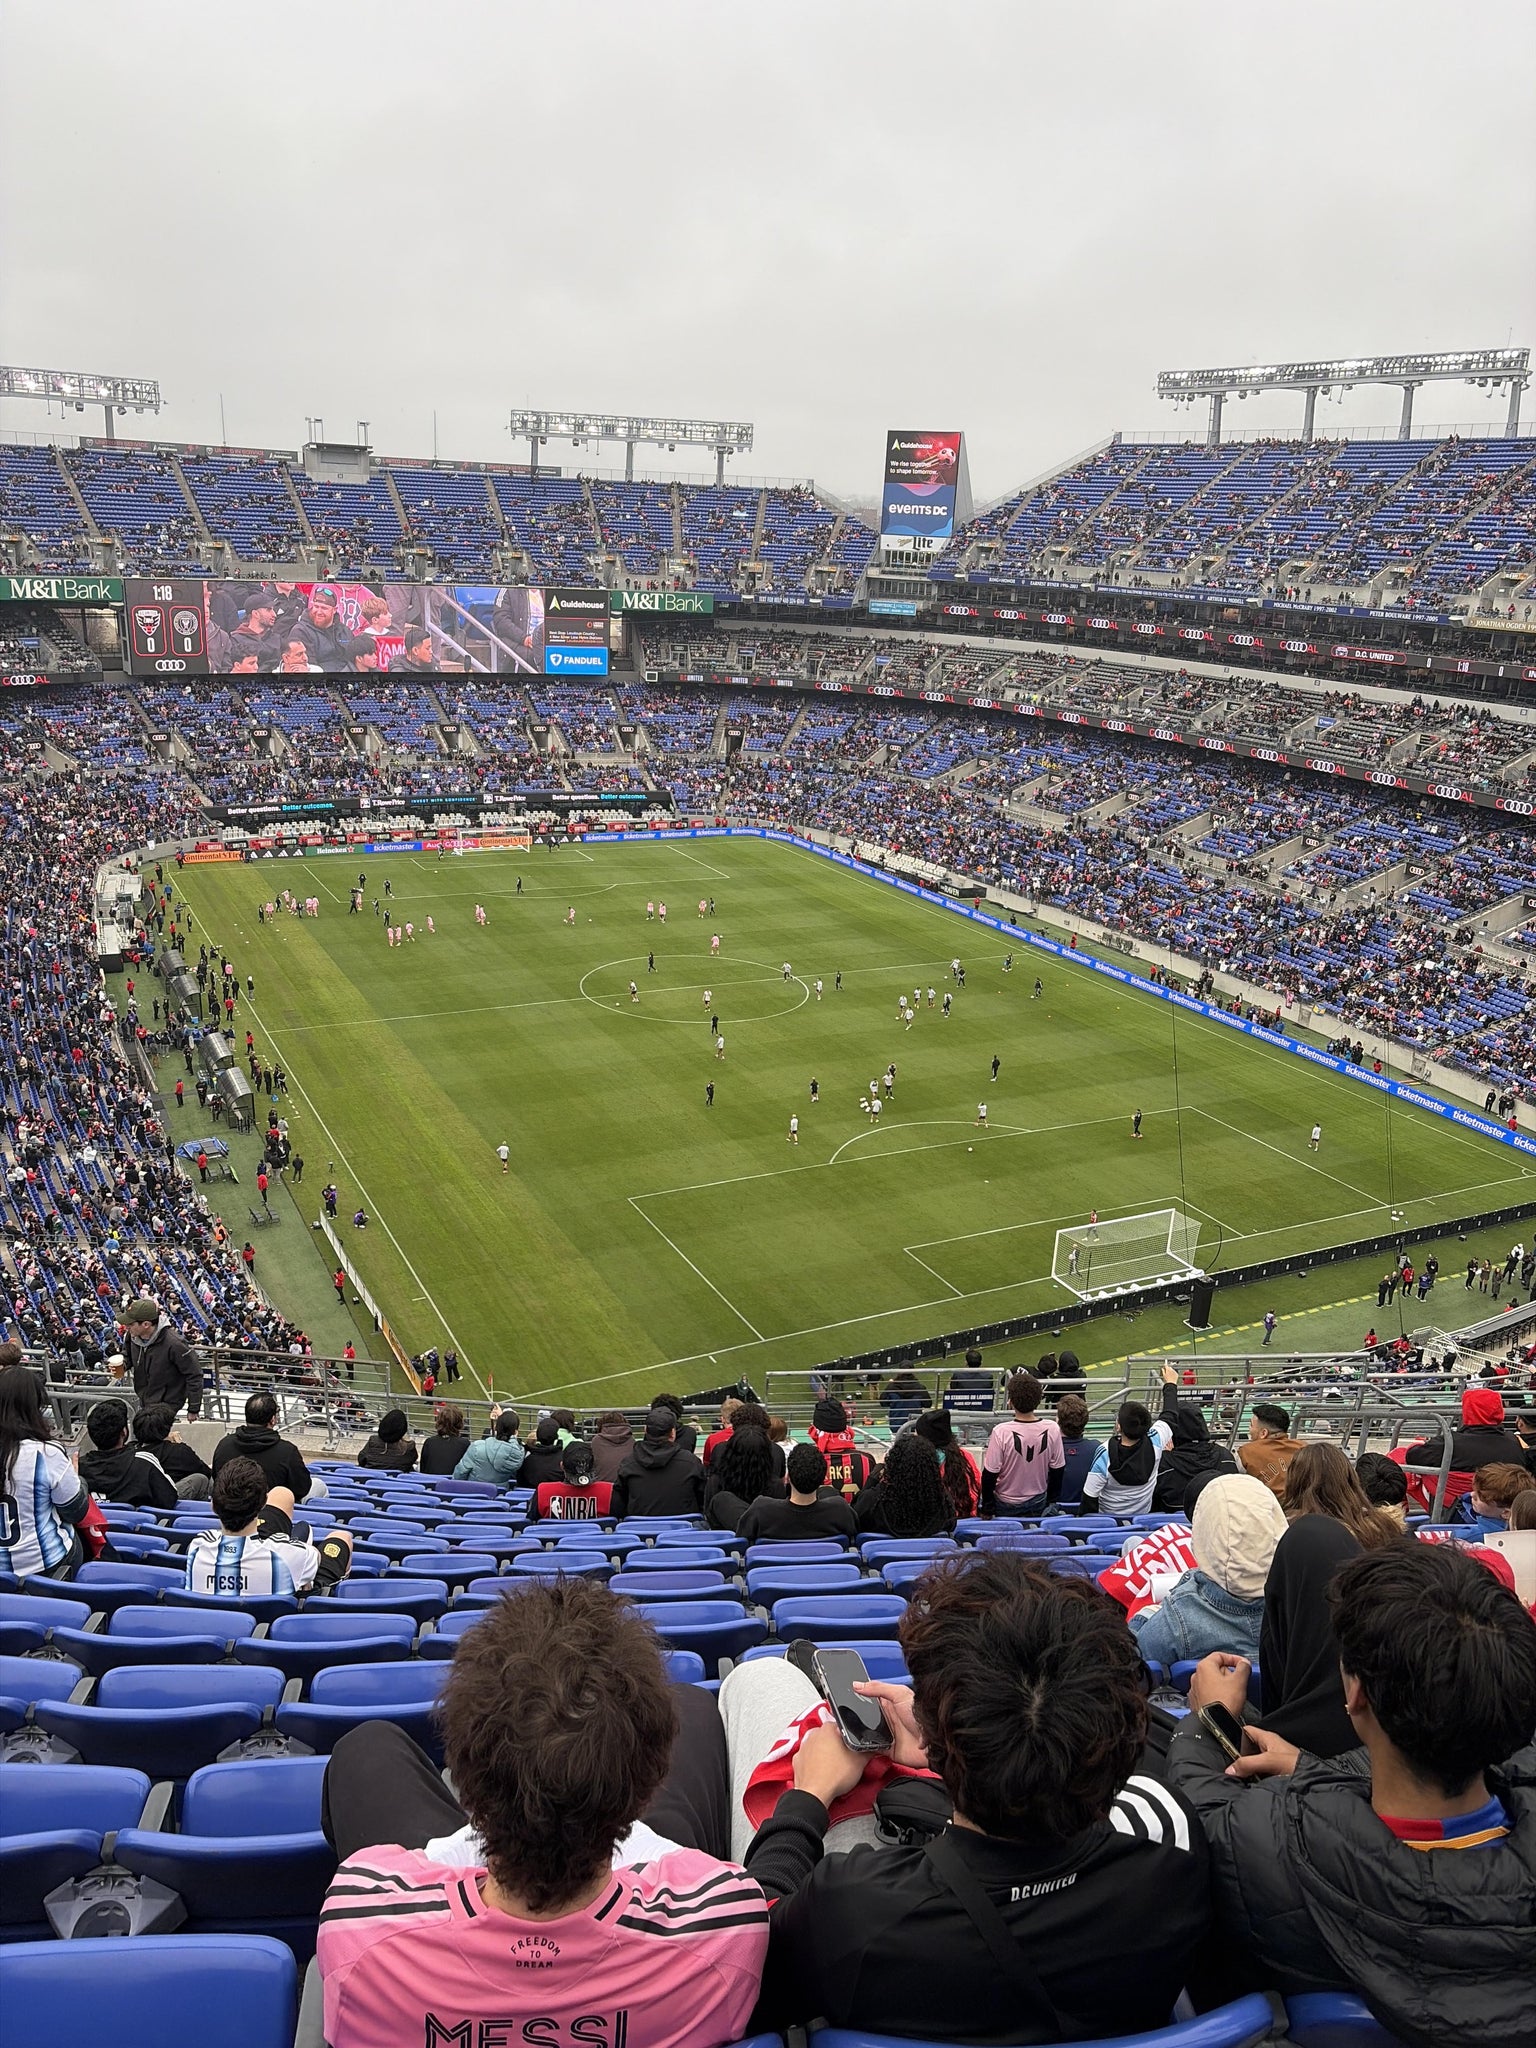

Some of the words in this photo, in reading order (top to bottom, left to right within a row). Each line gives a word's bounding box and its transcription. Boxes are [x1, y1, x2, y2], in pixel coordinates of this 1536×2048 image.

[910, 461, 932, 469] together
[912, 536, 933, 551] Lite
[9, 578, 62, 599] M&T
[64, 579, 112, 600] Bank
[152, 585, 173, 601] 1:18
[560, 600, 604, 609] Guidehouse
[621, 591, 664, 610] M&T
[665, 593, 704, 612] Bank
[1370, 610, 1384, 618] PETER
[1385, 612, 1411, 620] BOULWARE
[1476, 619, 1505, 628] JONATHAN
[1506, 621, 1526, 630] OGDEN
[147, 637, 156, 653] 0
[183, 636, 192, 653] 0
[563, 656, 603, 666] FANDUEL
[1369, 652, 1394, 661] UNITED
[1457, 661, 1470, 673] 1:18
[227, 807, 248, 815] Better
[248, 805, 281, 814] questions.
[302, 802, 335, 810] outcomes.
[623, 832, 656, 840] ticketmaster
[660, 830, 692, 838] ticketmaster
[316, 846, 347, 854] Heineken
[373, 843, 415, 852] ticketmaster
[1030, 935, 1059, 951] ticketmaster
[1061, 948, 1092, 964] ticketmaster
[1095, 961, 1127, 979] ticketmaster
[1130, 976, 1165, 996] ticketmaster
[1168, 991, 1204, 1012] ticketmaster
[1208, 1008, 1246, 1029] ticketmaster
[1251, 1026, 1291, 1048] ticketmaster
[1296, 1044, 1340, 1068] ticketmaster
[1345, 1064, 1391, 1090] ticketmaster
[1397, 1086, 1446, 1113] ticketmaster
[1452, 1110, 1507, 1139] ticketmaster
[564, 1496, 598, 1520] NBA
[206, 1575, 248, 1590] MESSI
[510, 1936, 561, 1957] FREEDOM
[530, 1950, 541, 1959] TO
[516, 1960, 553, 1969] DREAM
[424, 2009, 628, 2048] MESSI
